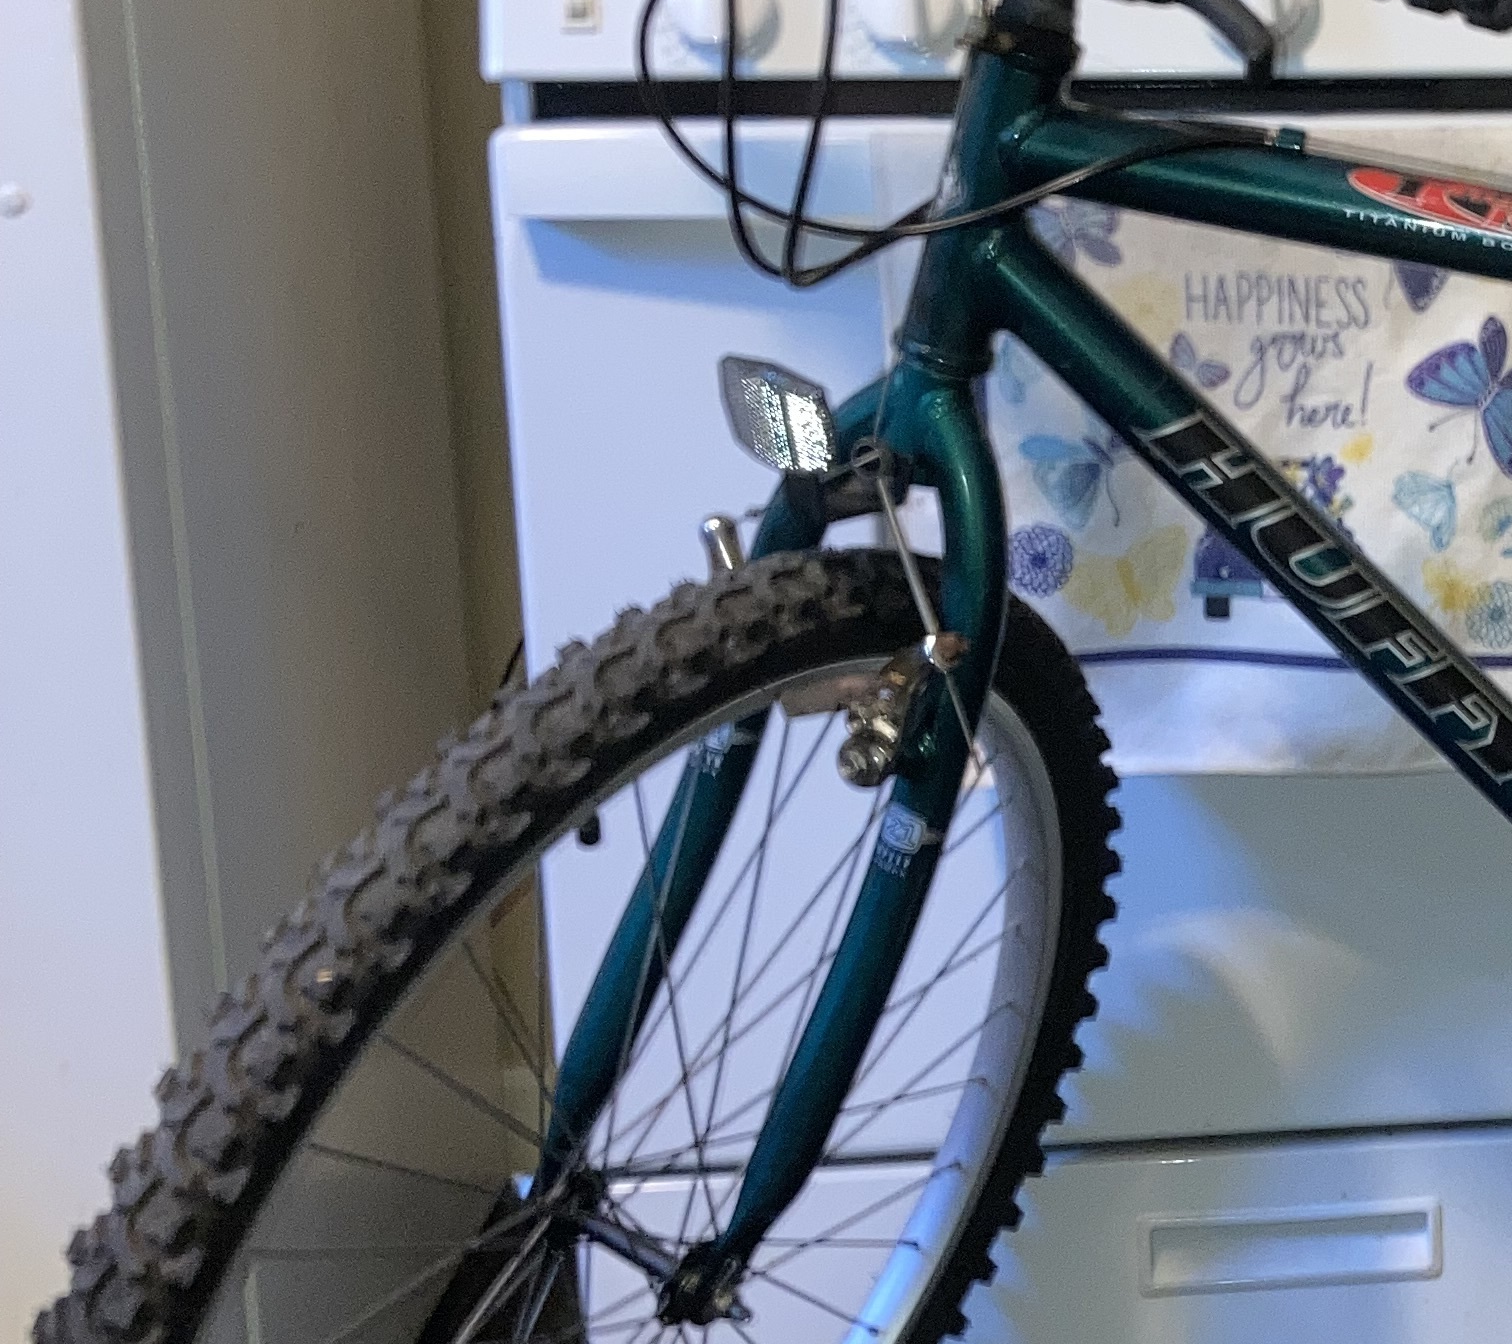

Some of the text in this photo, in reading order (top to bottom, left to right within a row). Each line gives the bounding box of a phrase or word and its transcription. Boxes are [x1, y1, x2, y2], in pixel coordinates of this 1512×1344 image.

[1343, 208, 1467, 243] TITANIUM
[1184, 270, 1370, 330] HAPPINESS
[1233, 330, 1344, 411] grows
[1280, 359, 1374, 429] here!
